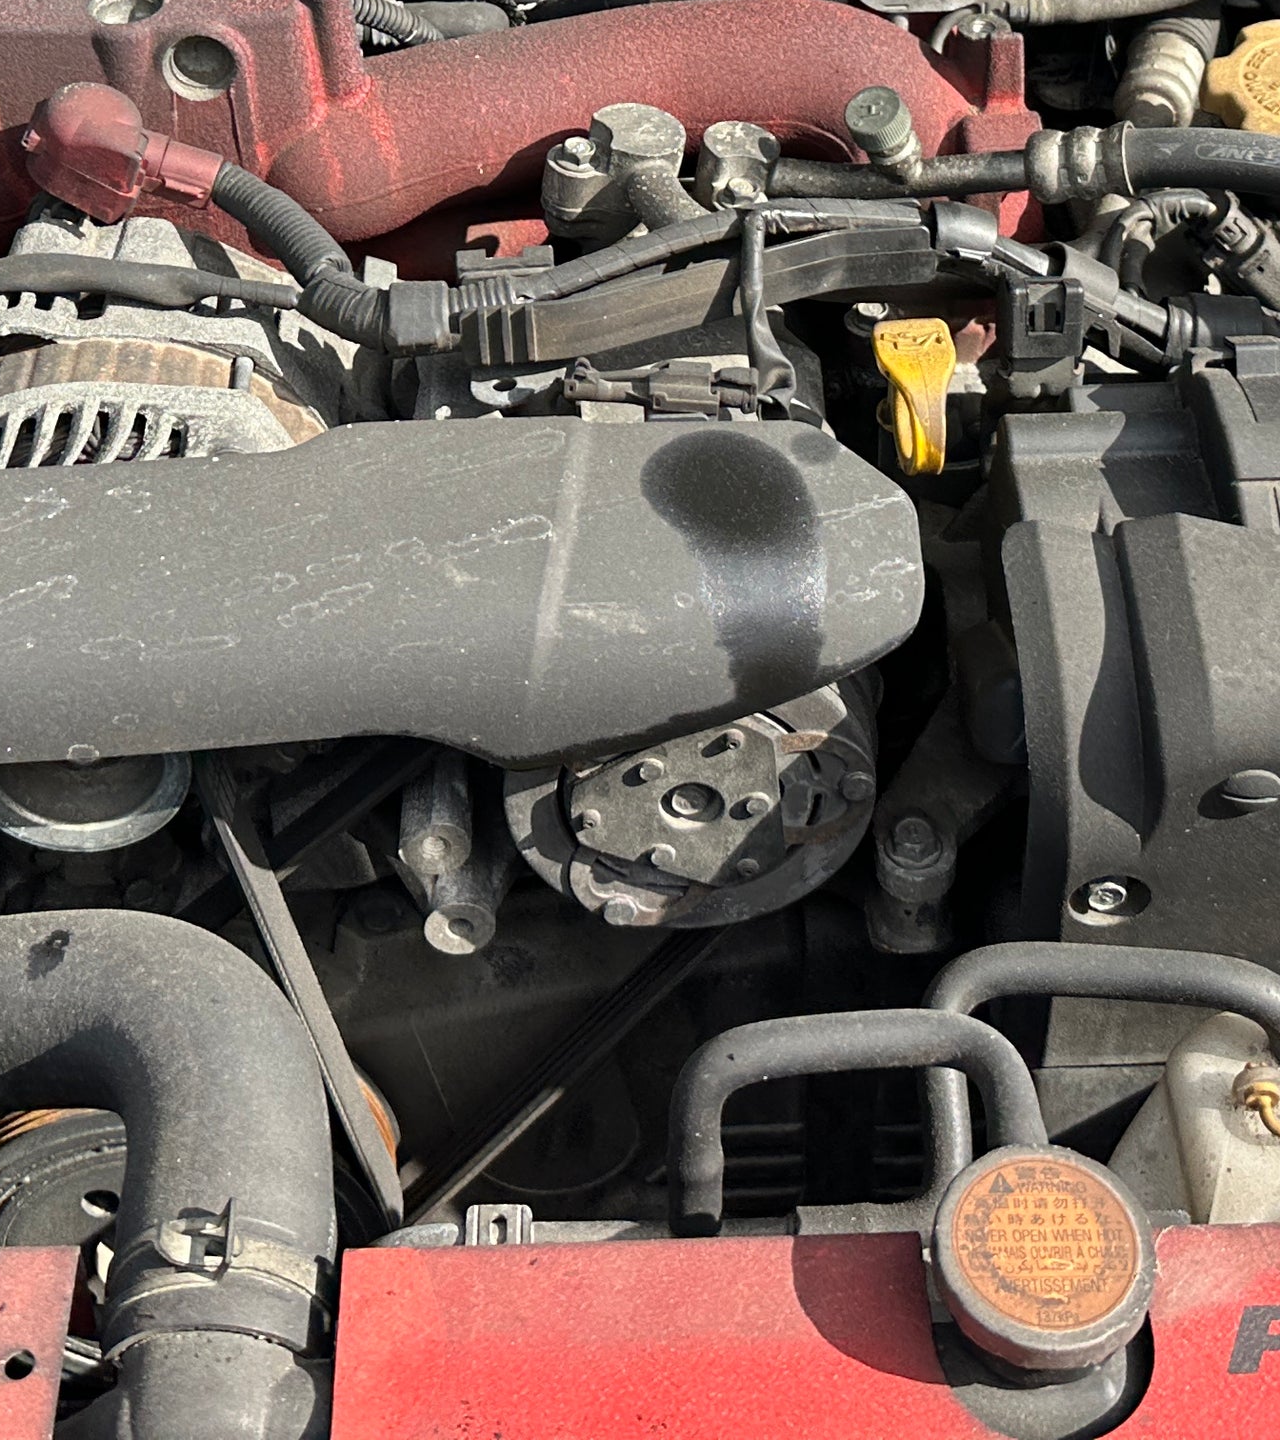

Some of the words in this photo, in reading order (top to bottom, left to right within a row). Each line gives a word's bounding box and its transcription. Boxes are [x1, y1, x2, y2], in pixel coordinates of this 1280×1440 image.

[1016, 1180, 1088, 1195] WARNING
[1012, 1228, 1048, 1243] OPEN
[1051, 1228, 1093, 1243] WHEN
[1096, 1228, 1123, 1243] HOT
[1030, 1244, 1073, 1259] OUVRIR
[995, 1277, 1108, 1293] AVERTISSEMENT
